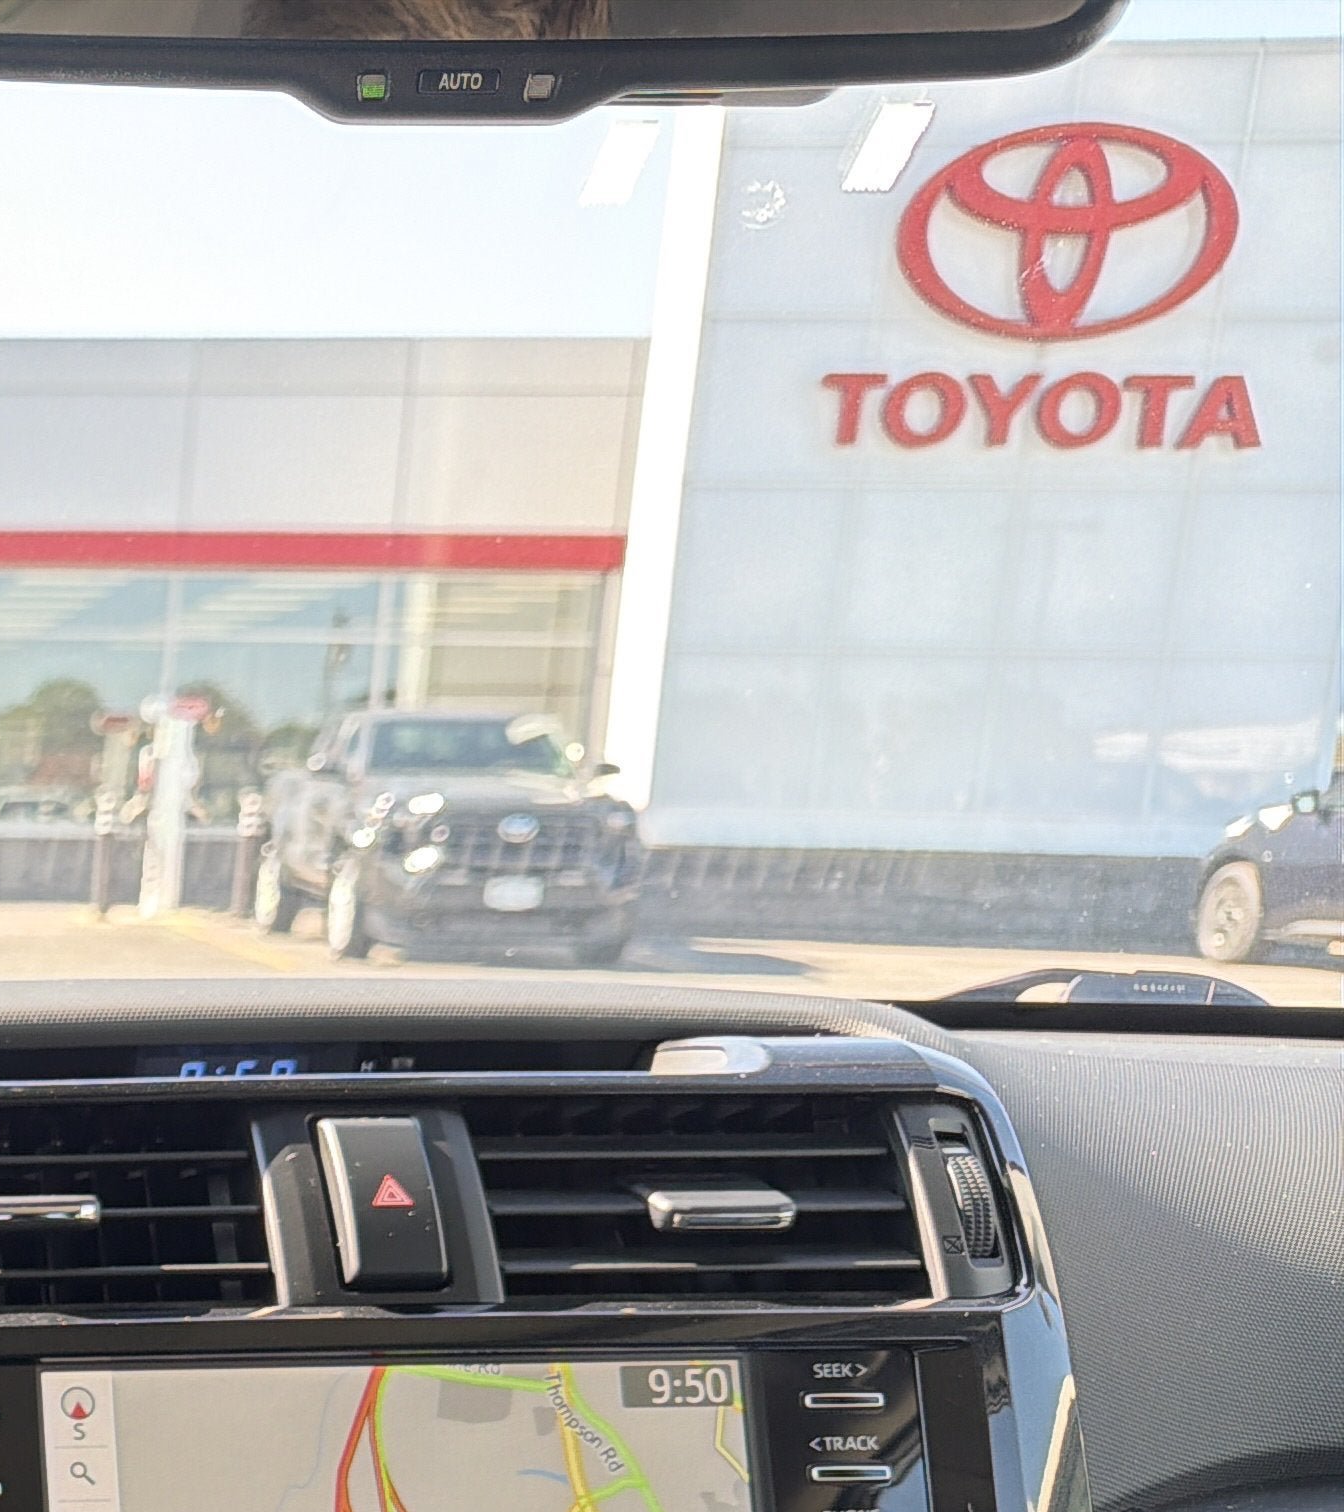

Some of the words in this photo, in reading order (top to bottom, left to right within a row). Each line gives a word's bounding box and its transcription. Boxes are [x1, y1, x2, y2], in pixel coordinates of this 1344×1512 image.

[438, 72, 483, 91] AUTO
[821, 371, 1262, 450] TOYOTA
[648, 1367, 728, 1404] 9:50
[73, 1423, 86, 1440] S
[544, 1372, 602, 1450] Thompson
[599, 1446, 624, 1473] Rd
